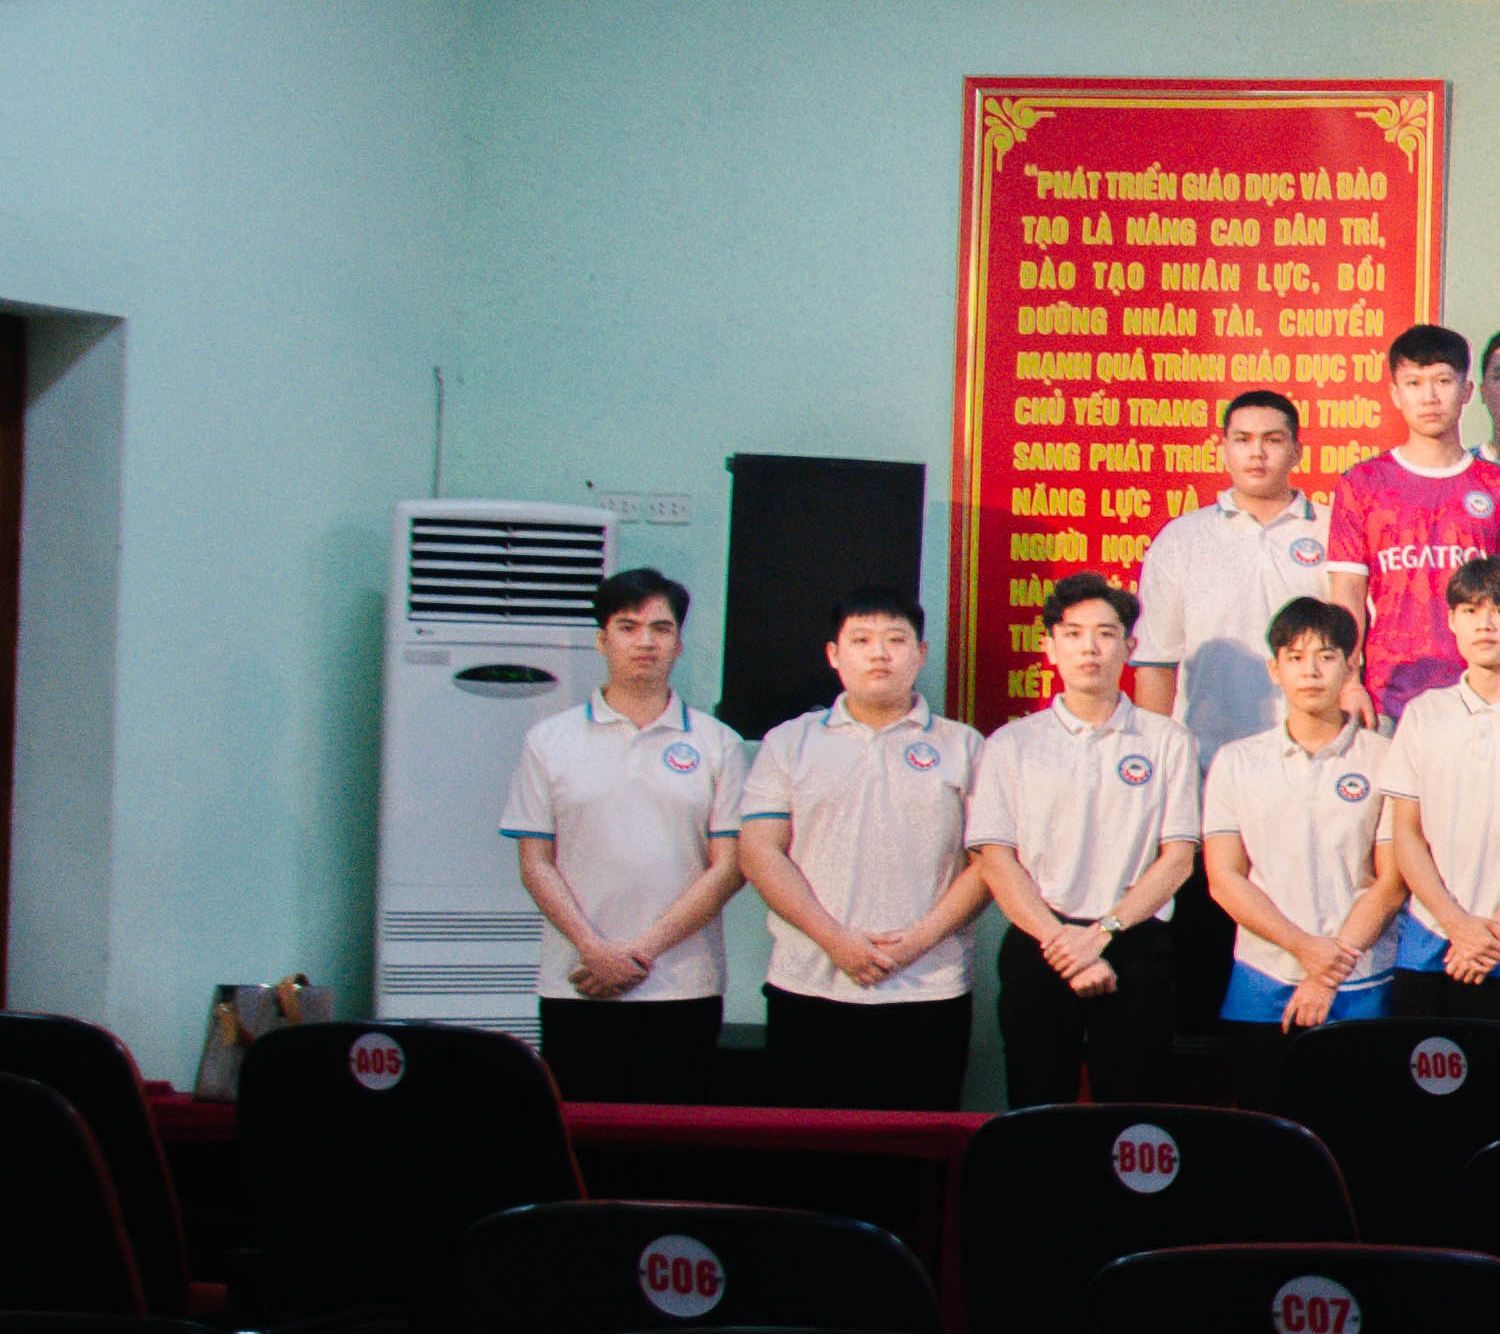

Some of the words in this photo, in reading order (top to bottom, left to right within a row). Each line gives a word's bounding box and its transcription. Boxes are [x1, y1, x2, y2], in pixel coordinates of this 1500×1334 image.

[1107, 162, 1176, 200] TRIỂN
[1182, 167, 1240, 201] GIÁO
[1245, 173, 1294, 206] DỤC
[1301, 167, 1332, 199] VÀ
[1337, 167, 1387, 200] ĐÀO
[1022, 216, 1069, 250] TẠO
[1083, 212, 1112, 244] LÀ
[1127, 213, 1197, 246] NÂNG
[1211, 218, 1260, 246] CAO
[1274, 214, 1326, 246] DÂN
[1340, 213, 1386, 249] TRÍ,
[1020, 257, 1075, 289] ĐÀO
[1094, 263, 1144, 296] TẠO
[1162, 259, 1240, 290] NHÂN
[1258, 263, 1320, 296] LỰC,
[1338, 256, 1385, 291] BỒI
[1018, 301, 1107, 335] DƯỠNG
[1124, 304, 1197, 336] NHÂN
[1279, 299, 1384, 337] CHUYỂN
[1016, 353, 1094, 387] MẠNH
[1097, 349, 1146, 383] QUÁ
[1152, 348, 1225, 382] TRÌNH
[1231, 349, 1290, 383] GIÁO
[1295, 355, 1346, 388] DỤC
[1352, 351, 1385, 382] TỪ
[1015, 390, 1065, 425] CHỦ
[1074, 391, 1119, 425] YẾU
[1128, 399, 1207, 427] TRANG
[1319, 396, 1381, 427] THỨC
[1013, 443, 1080, 471] SANG
[1090, 441, 1154, 472] PHÁT
[1165, 434, 1228, 472] TRIỂ
[1012, 483, 1085, 516] NĂNG
[1102, 485, 1151, 524] LỰC
[1167, 485, 1200, 518] VÀ
[1010, 532, 1087, 562] NGƯỜI
[1008, 664, 1052, 698] KẾT
[1417, 1052, 1463, 1079] A06
[1116, 1140, 1174, 1175] B06
[647, 1253, 718, 1297] C06
[1282, 1295, 1350, 1334] C07
